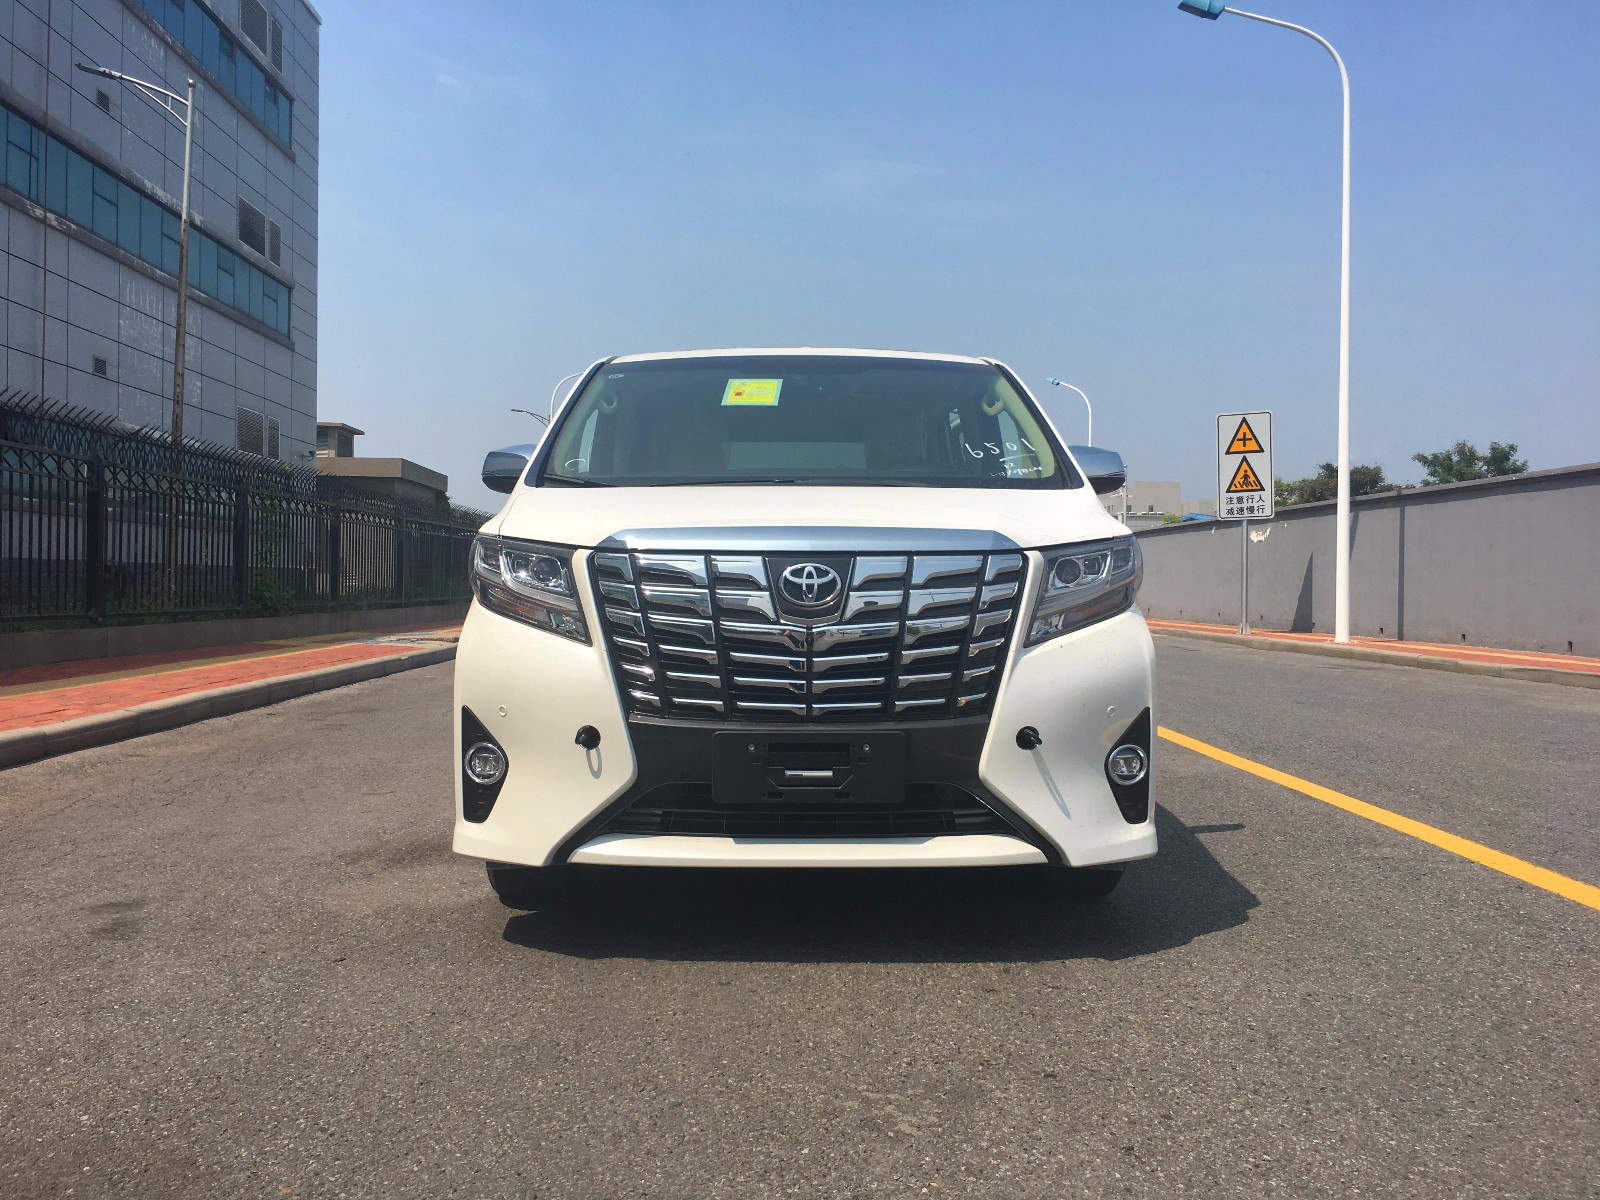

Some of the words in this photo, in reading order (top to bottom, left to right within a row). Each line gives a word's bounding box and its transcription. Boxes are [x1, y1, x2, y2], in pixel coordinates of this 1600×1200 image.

[1225, 494, 1266, 505] 注意行人
[1225, 505, 1266, 516] 减速慢行
